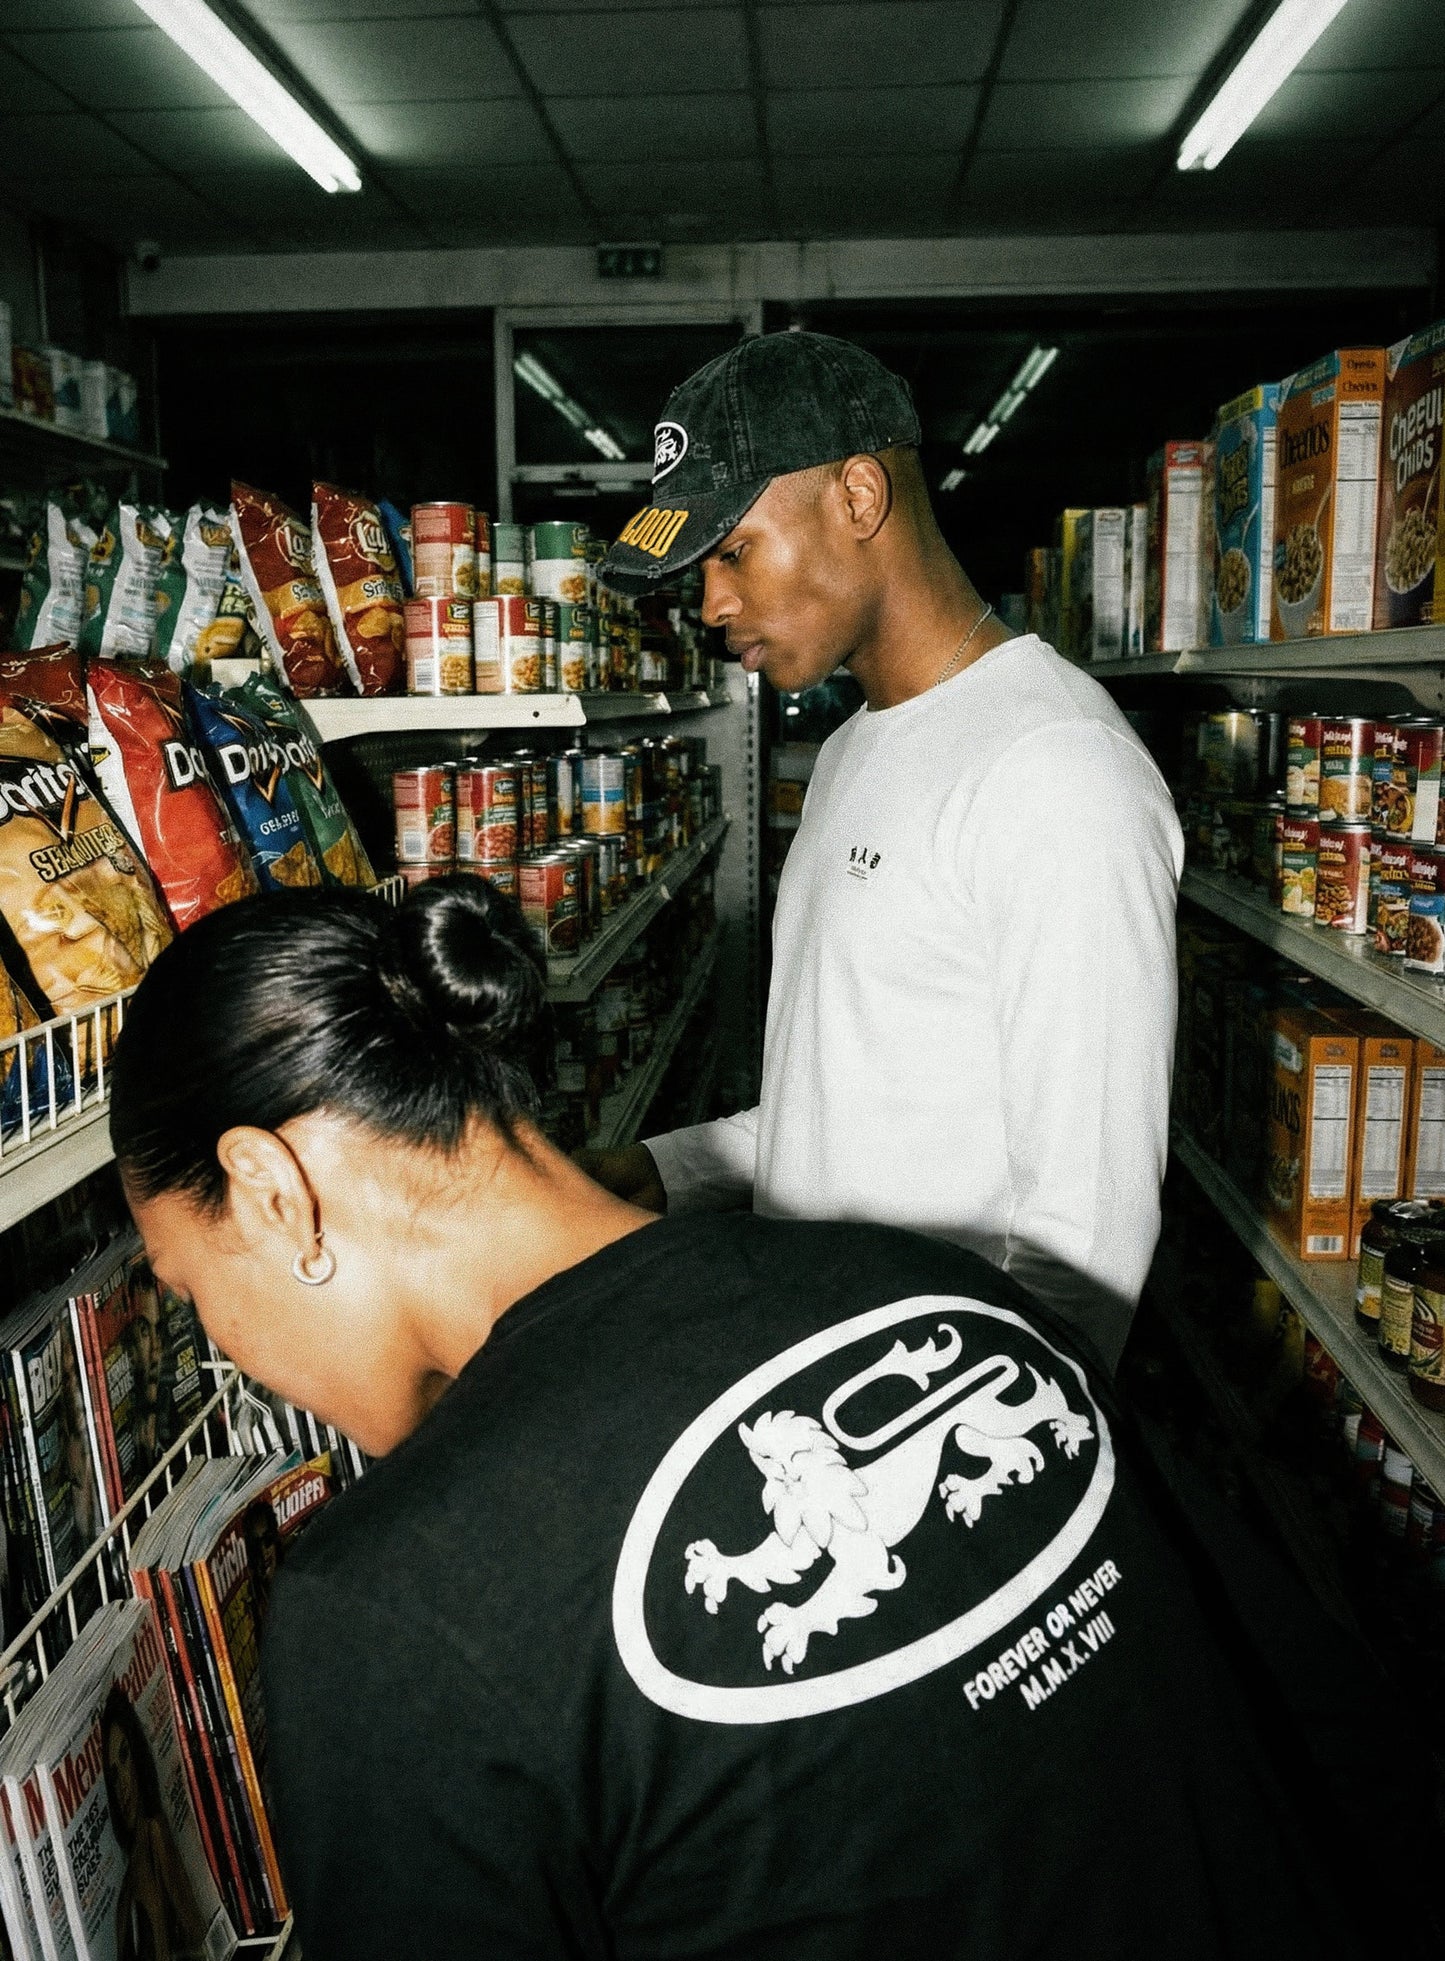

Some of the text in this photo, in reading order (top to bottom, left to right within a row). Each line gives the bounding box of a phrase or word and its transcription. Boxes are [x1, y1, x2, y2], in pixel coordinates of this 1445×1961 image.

[962, 1559, 1123, 1711] FOREVER OR NEVER
[1019, 1610, 1116, 1711] M.M.X.VIII
